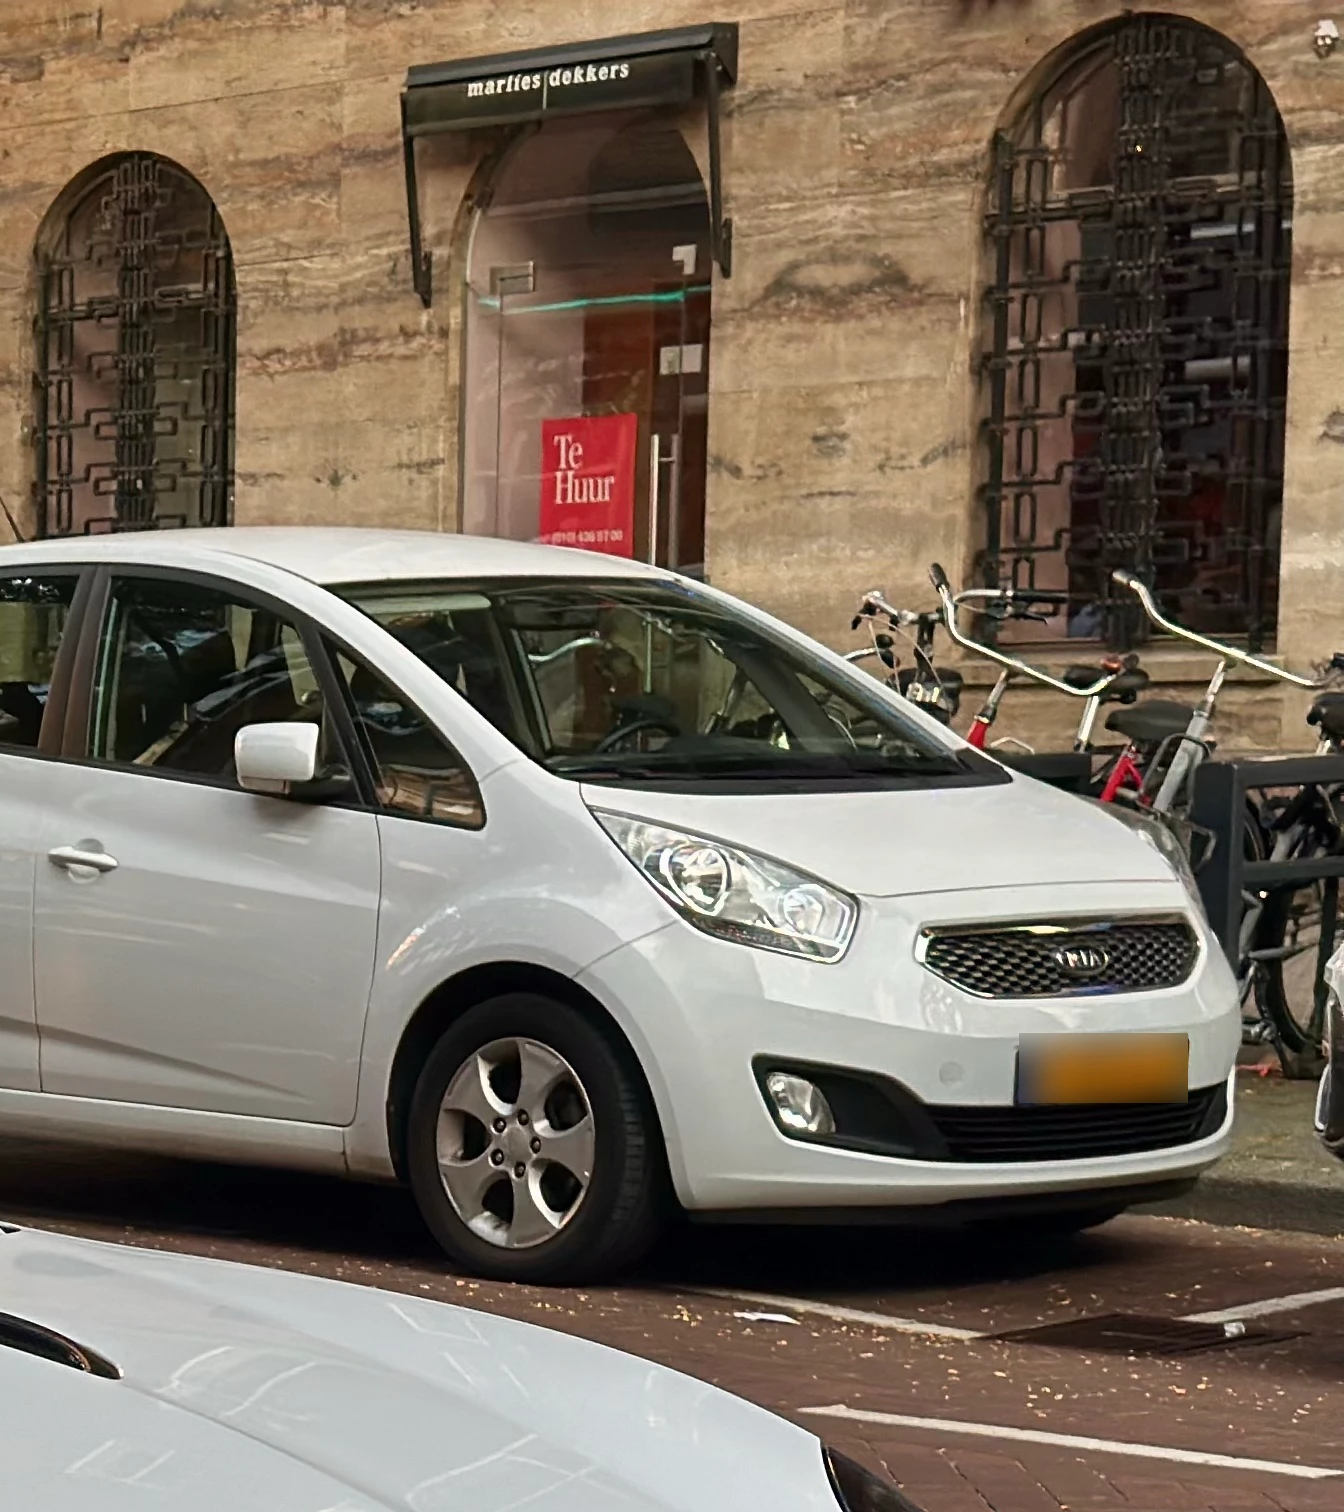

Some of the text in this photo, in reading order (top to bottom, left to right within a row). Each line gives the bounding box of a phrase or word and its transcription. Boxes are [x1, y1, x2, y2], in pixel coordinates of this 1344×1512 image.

[548, 63, 631, 88] dekkers
[553, 434, 584, 469] Te
[555, 469, 615, 505] Huur
